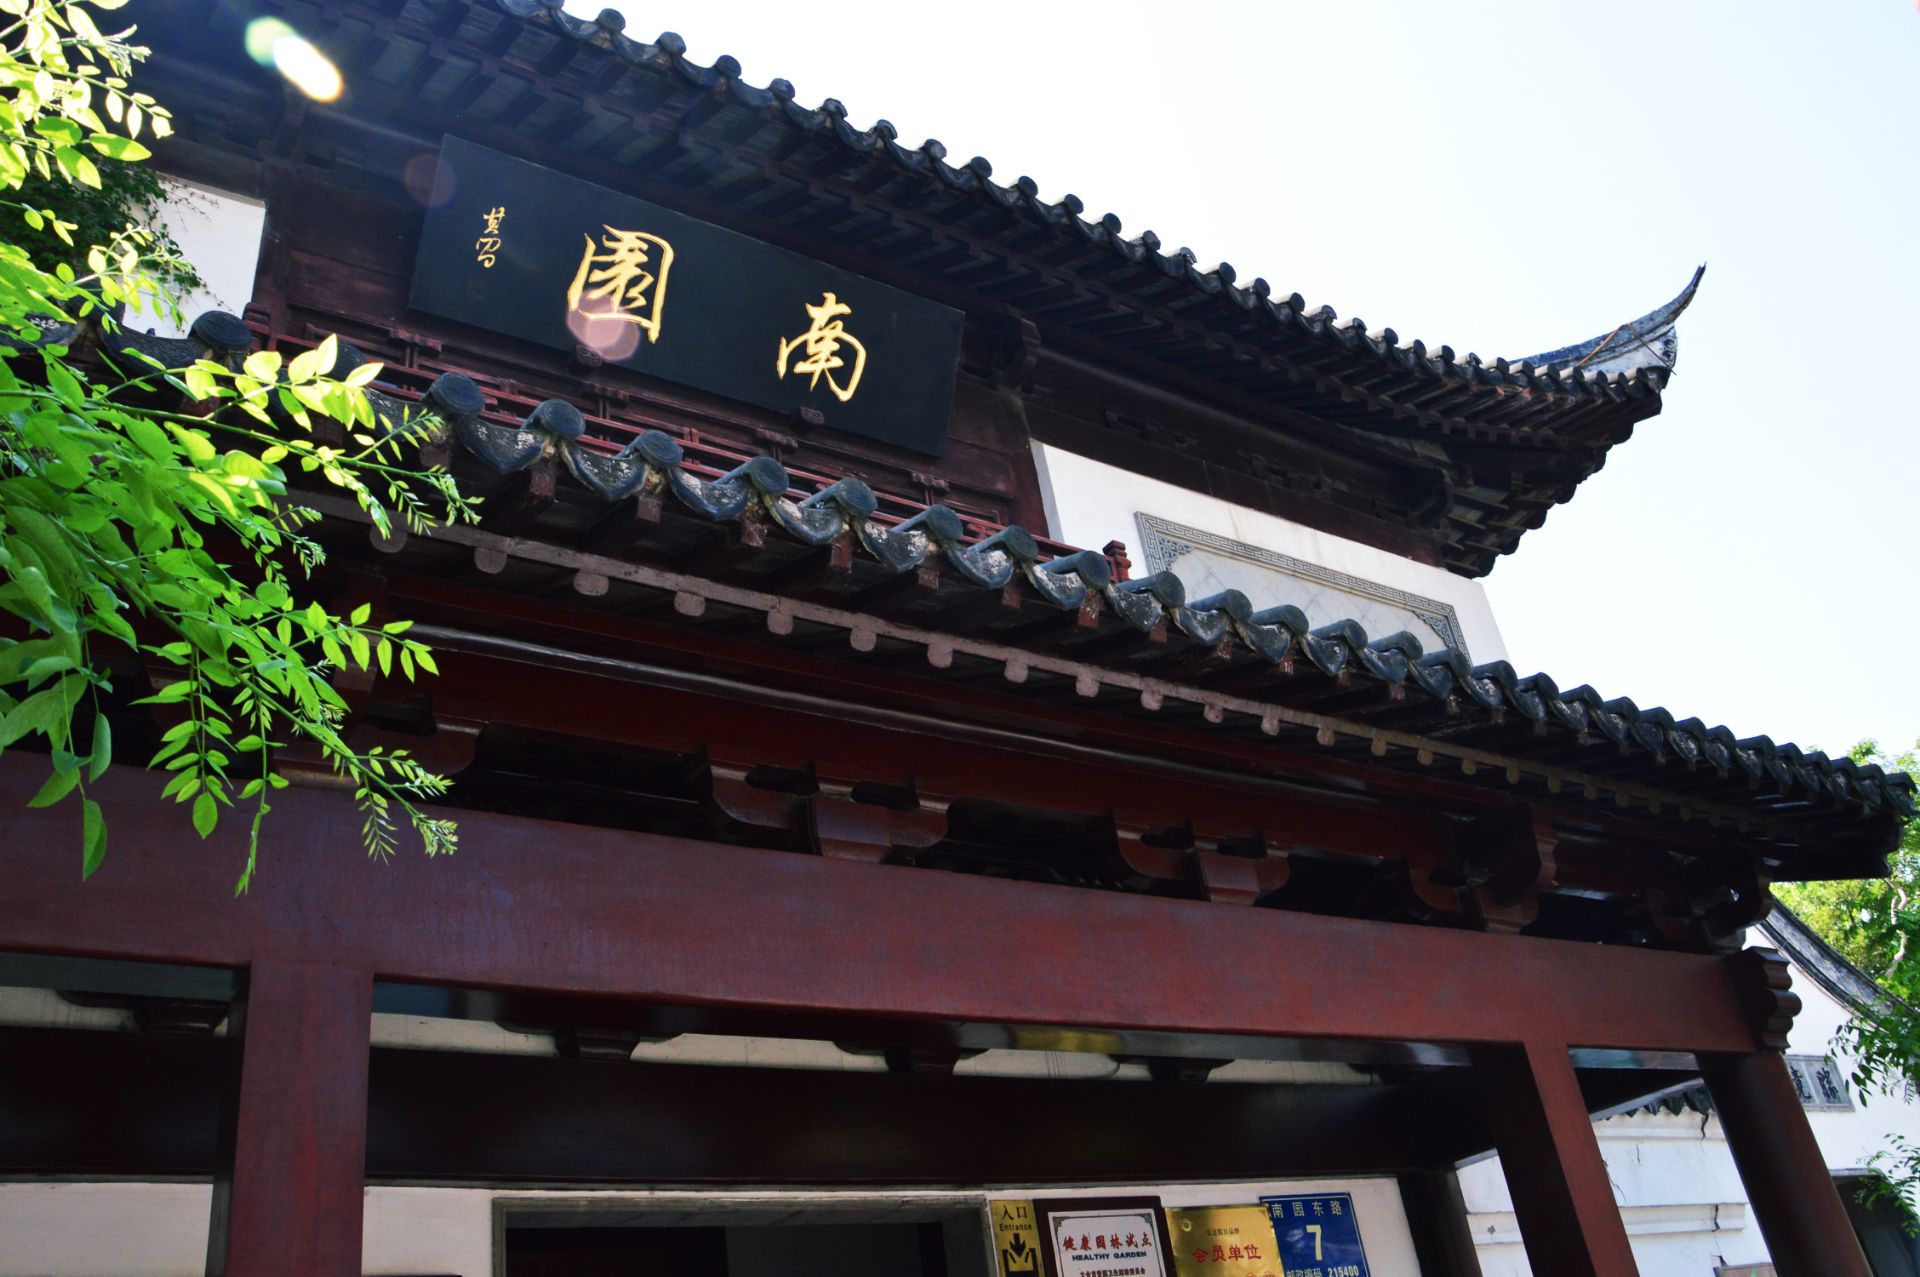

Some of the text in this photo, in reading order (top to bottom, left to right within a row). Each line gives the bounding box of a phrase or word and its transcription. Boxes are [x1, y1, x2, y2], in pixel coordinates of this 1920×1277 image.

[1002, 1204, 1028, 1220] 入口
[1271, 1200, 1342, 1219] 南园东路
[999, 1223, 1033, 1232] Entrance
[1306, 1224, 1323, 1261] 7
[1072, 1251, 1147, 1262] HEALTHY GARDEN
[1192, 1244, 1262, 1263] 会员单位
[1327, 1264, 1360, 1277] 215400
